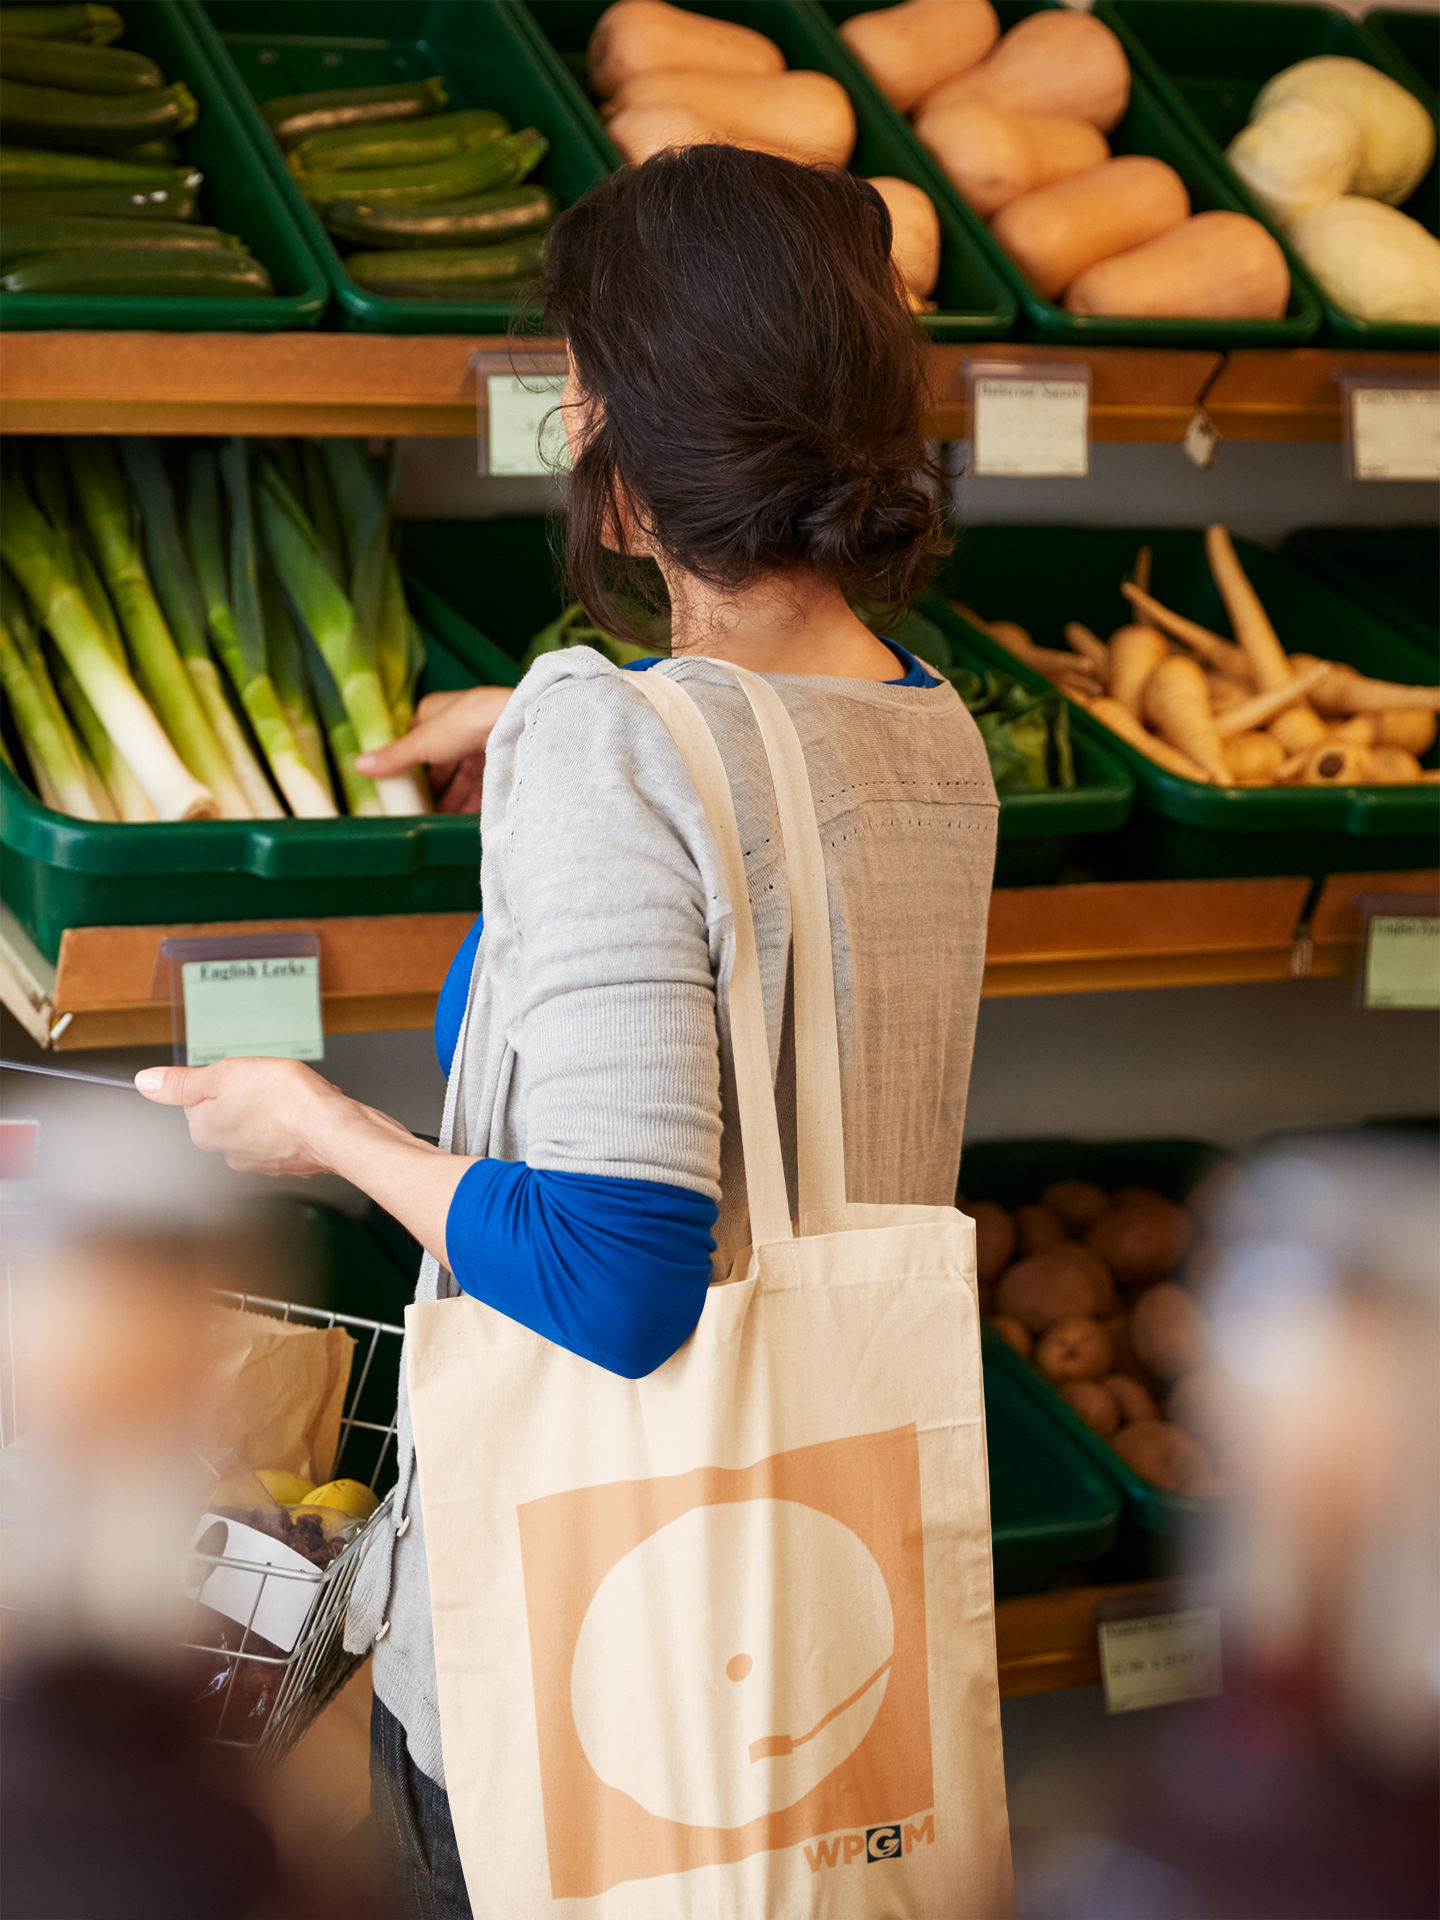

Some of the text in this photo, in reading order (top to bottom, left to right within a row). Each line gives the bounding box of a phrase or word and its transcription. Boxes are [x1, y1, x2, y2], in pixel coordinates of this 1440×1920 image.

[200, 958, 306, 980] English Leeks
[803, 1814, 935, 1873] WPGM
